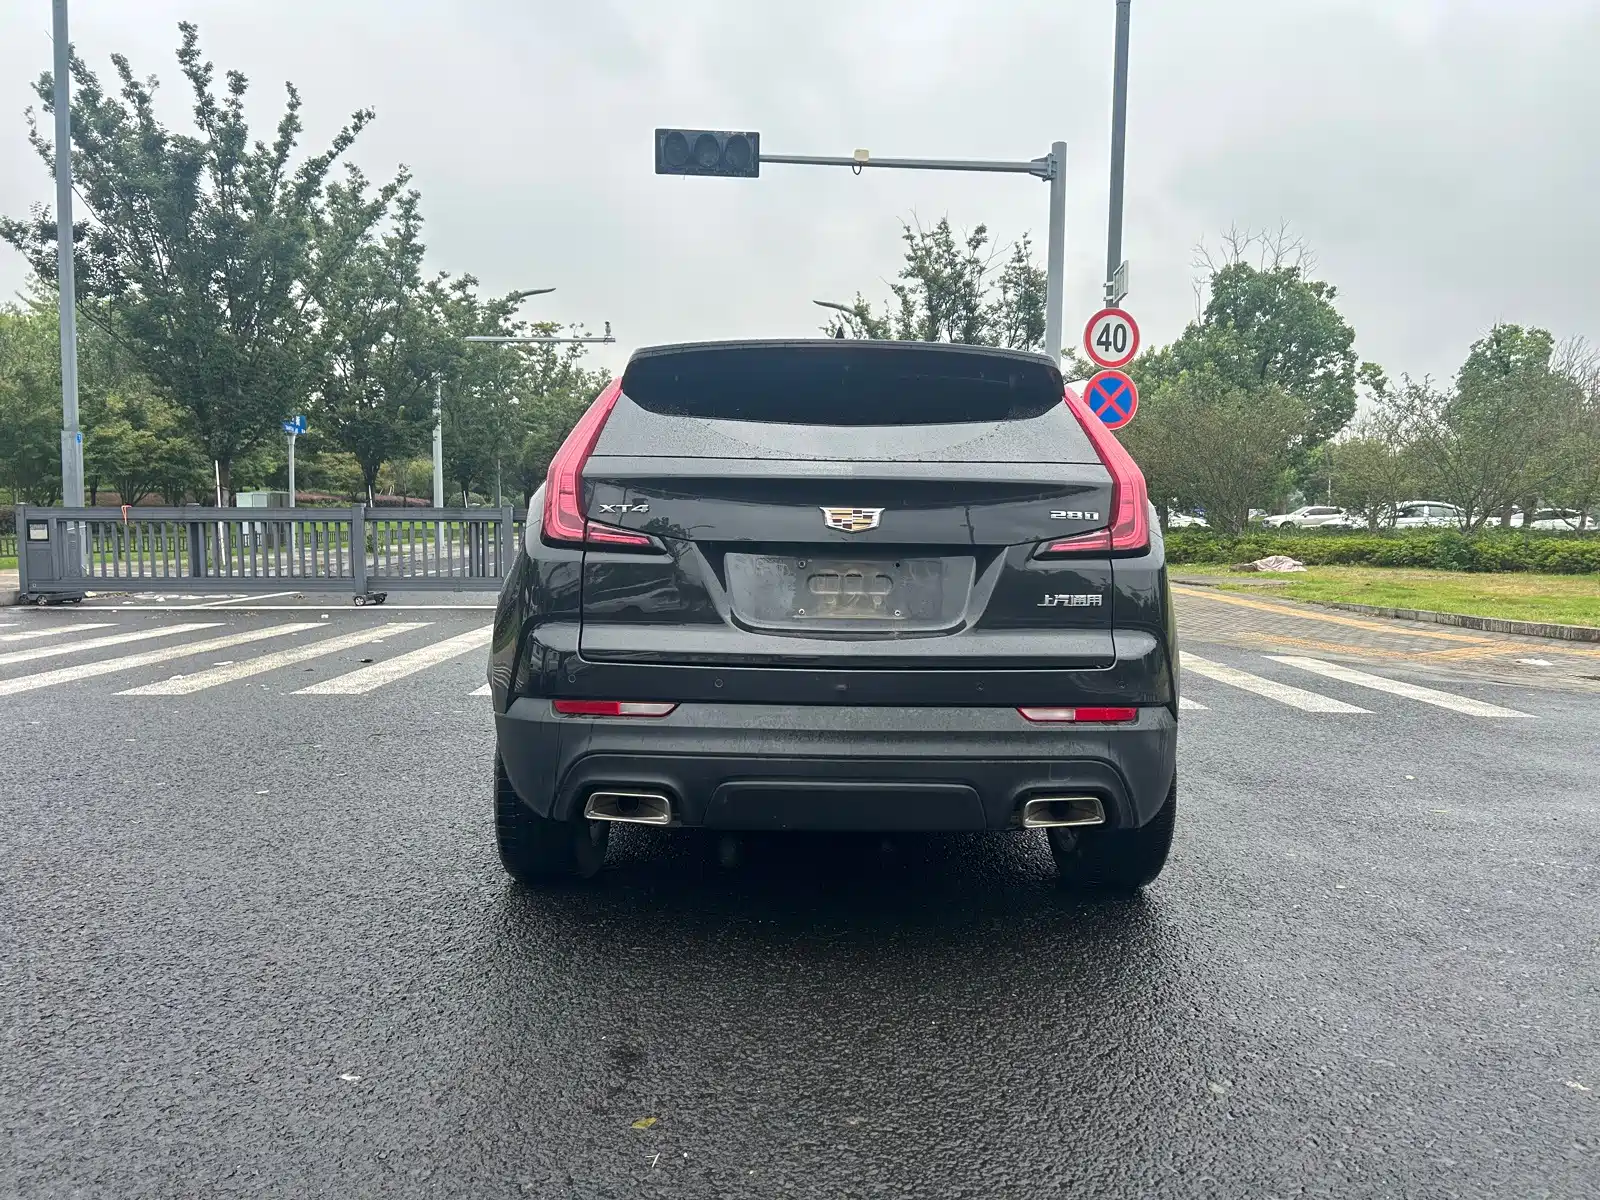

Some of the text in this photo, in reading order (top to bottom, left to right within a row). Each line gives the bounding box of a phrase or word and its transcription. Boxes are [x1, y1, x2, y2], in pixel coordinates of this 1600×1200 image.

[1096, 323, 1127, 353] 40
[599, 504, 649, 513] XT4
[1050, 510, 1099, 520] 280
[1037, 594, 1102, 607] 上汽通用
